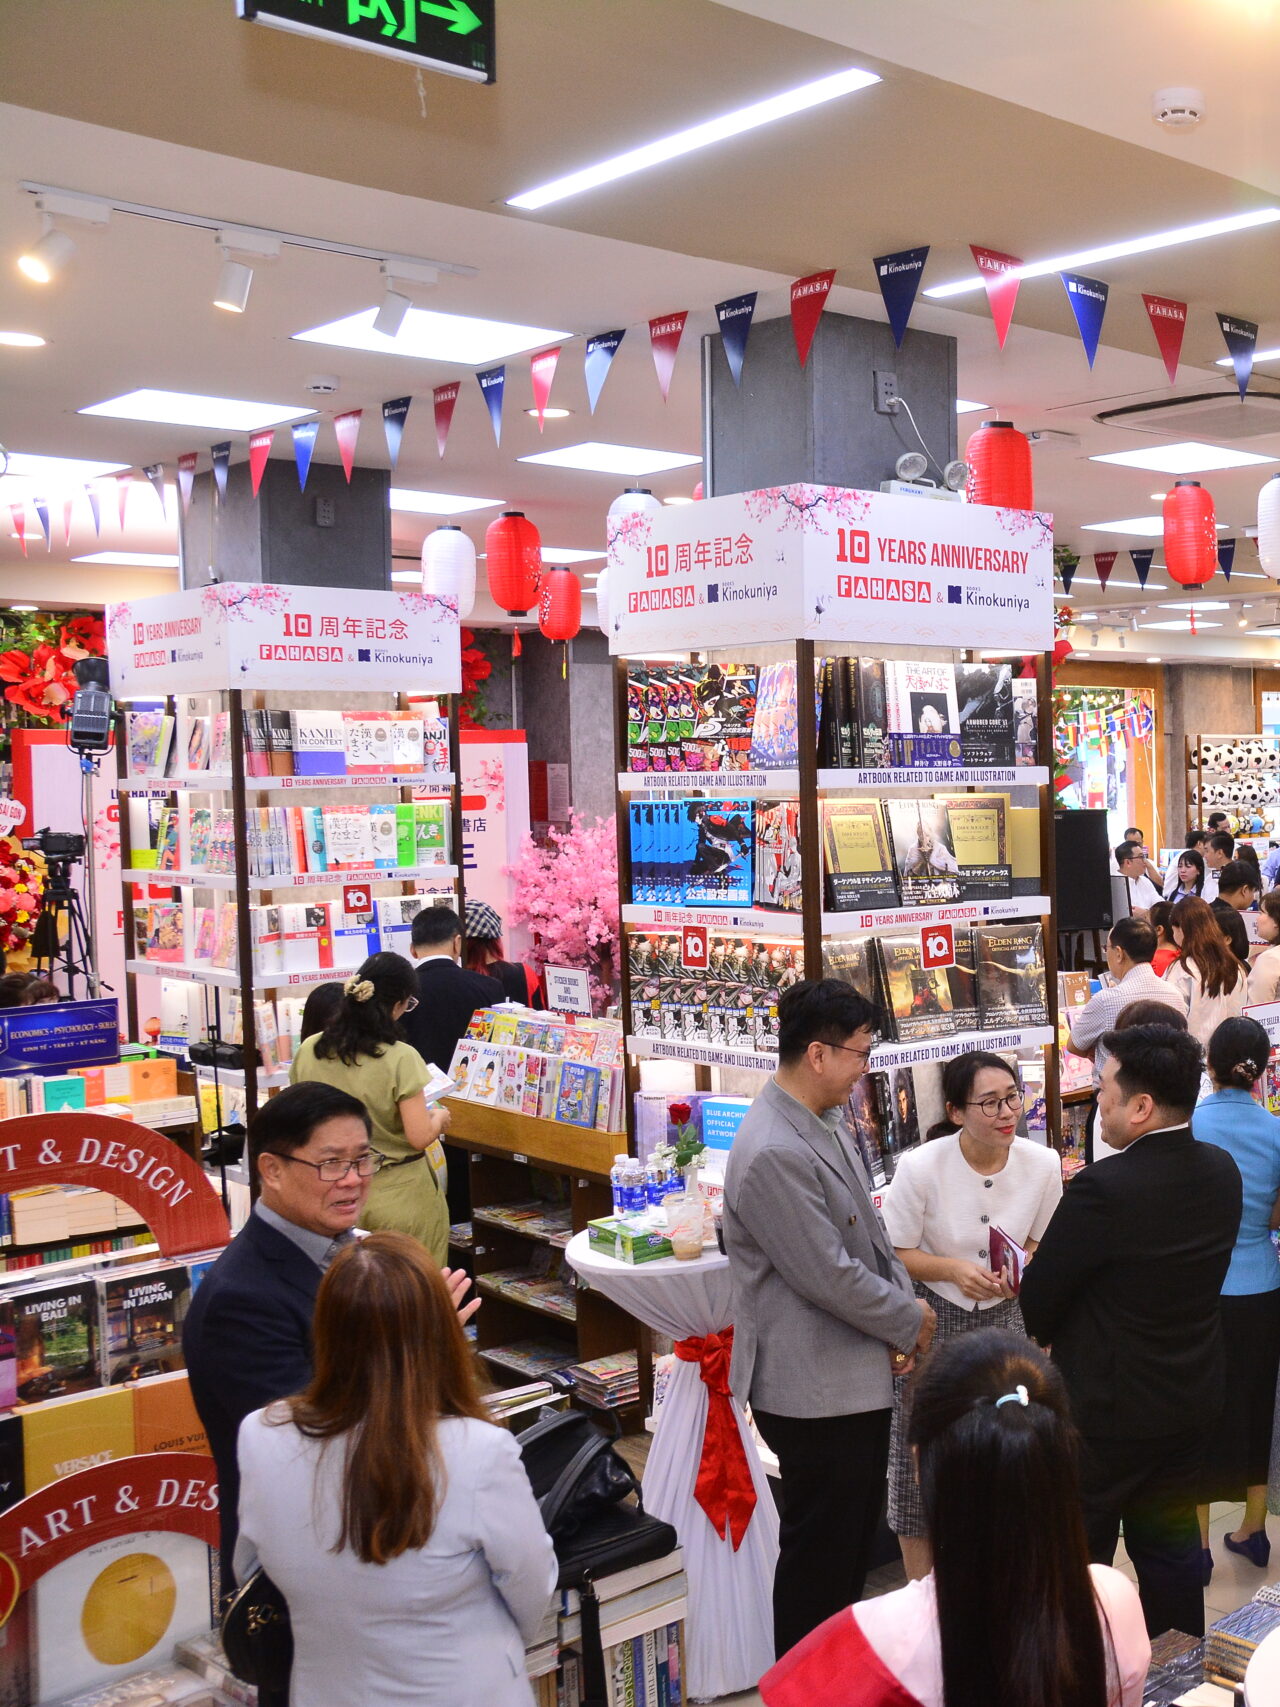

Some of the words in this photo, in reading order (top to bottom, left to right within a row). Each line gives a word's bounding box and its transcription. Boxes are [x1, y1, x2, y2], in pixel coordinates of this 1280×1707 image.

[888, 259, 923, 275] Kinokuniya
[792, 279, 830, 300] FAHASA
[1078, 284, 1105, 301] Kinokuniya
[725, 303, 753, 319] Kinokuniya
[1149, 303, 1185, 320] FAHASA
[652, 320, 682, 337] FAHASA
[646, 544, 669, 578] 10
[674, 533, 754, 573] 周年記念
[836, 528, 870, 565] 10
[877, 537, 926, 566] YEARS
[930, 541, 1029, 575] ANNIVERSARY
[628, 584, 694, 613] FAHASA
[698, 594, 704, 604] &
[722, 583, 778, 602] Kinokuniya
[837, 575, 932, 603] FAHASA
[936, 592, 944, 603] &
[966, 592, 1030, 610] Kinokuniya
[146, 623, 163, 640] YEARS
[164, 617, 202, 638] ANNIVERSARY
[283, 613, 312, 637] 10
[319, 616, 408, 639] 周年記念
[260, 644, 343, 662] FAHASA
[375, 653, 433, 666] Kinokuniya
[906, 667, 920, 675] THE
[921, 667, 936, 676] ART
[937, 668, 947, 676] OF
[299, 728, 333, 738] KANJI
[295, 778, 311, 786] YEARS
[644, 776, 667, 787] ARTBOOK
[668, 776, 690, 787] RELATED
[691, 776, 698, 786] TO
[699, 776, 714, 786] GAME
[715, 776, 726, 786] AND
[727, 775, 767, 786] ILLUSTRATION
[858, 771, 892, 784] ARTBOOK
[894, 771, 923, 783] RELATED
[924, 771, 933, 782] TO
[934, 770, 954, 782] GAME
[956, 770, 969, 782] AND
[970, 770, 1016, 781] ILLUSTRATION
[307, 874, 342, 883] 周年記念
[664, 911, 693, 923] 周年記念
[860, 915, 872, 928] 10
[875, 915, 892, 927] YEARS
[893, 912, 933, 925] ANNIVERSARY
[938, 908, 976, 920] FAHASA
[988, 939, 1011, 947] ELDEN
[1012, 937, 1033, 946] RING
[302, 974, 318, 982] YEARS
[319, 971, 353, 980] ANNIVERSARY
[1267, 1016, 1280, 1026] SELLER
[10, 1028, 49, 1039] ECONOMICS
[53, 1024, 95, 1035] PSYCHOLOGY
[653, 1043, 676, 1056] ARTBOOK
[677, 1046, 699, 1060] RELATED
[700, 1050, 706, 1061] TO
[708, 1052, 723, 1064] GAME
[725, 1053, 735, 1065] AND
[737, 1055, 776, 1071] ILLUSTRATION
[870, 1051, 899, 1068] RTBOOK
[901, 1049, 925, 1063] RELATED
[929, 1047, 940, 1058] TO
[941, 1044, 960, 1057] GAME
[977, 1034, 1021, 1052] ILLUSTRATION
[706, 1109, 721, 1117] BLUE
[722, 1110, 746, 1119] ARCHIV
[706, 1119, 735, 1128] OFFICIAL
[38, 1138, 62, 1165] &
[77, 1137, 193, 1208] DESIGN
[128, 1282, 167, 1298] LIVING
[25, 1299, 67, 1315] LIVING
[68, 1294, 82, 1307] IN
[122, 1299, 136, 1310] IN
[138, 1290, 172, 1307] JAPAN
[41, 1308, 67, 1322] BALI
[153, 1437, 185, 1452] LOUIS
[54, 1450, 113, 1477] VERSACE
[20, 1495, 97, 1558] ART
[115, 1485, 140, 1514] &
[156, 1478, 220, 1511] DES
[624, 1640, 633, 1689] GARDEN
